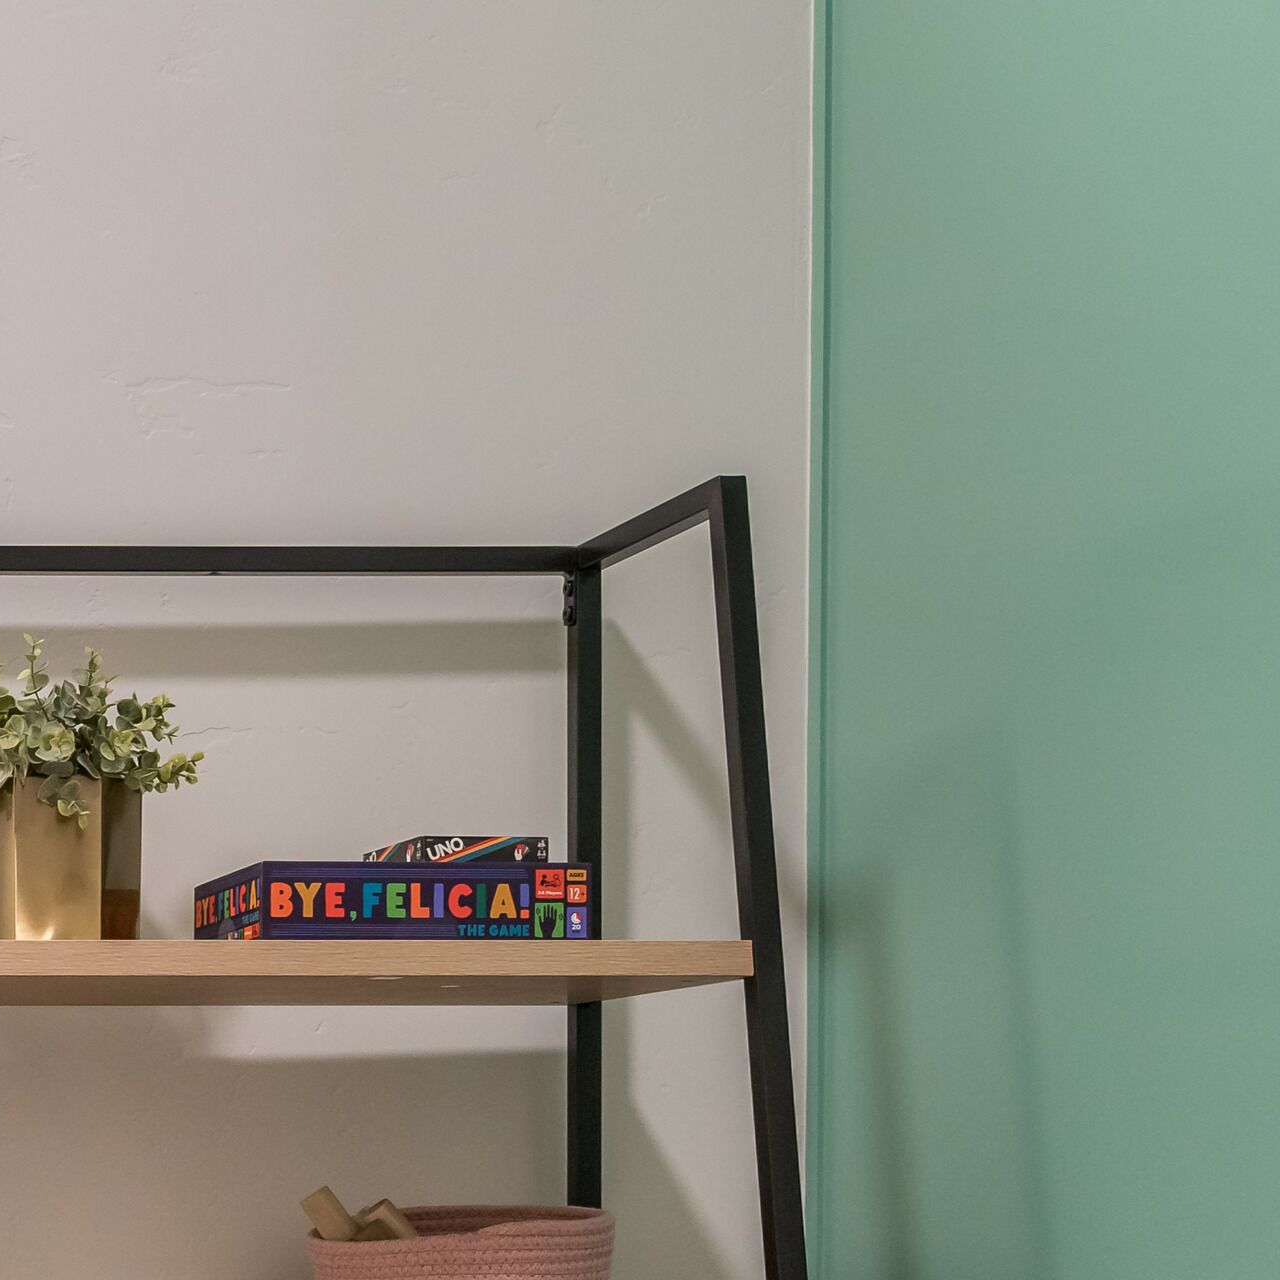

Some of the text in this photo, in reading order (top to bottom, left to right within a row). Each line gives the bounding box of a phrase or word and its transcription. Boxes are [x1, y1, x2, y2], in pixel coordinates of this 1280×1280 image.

[426, 837, 464, 861] UNO
[270, 883, 357, 921] BYE,
[362, 883, 530, 919] FELICIA!
[458, 924, 530, 937] THE GAME
